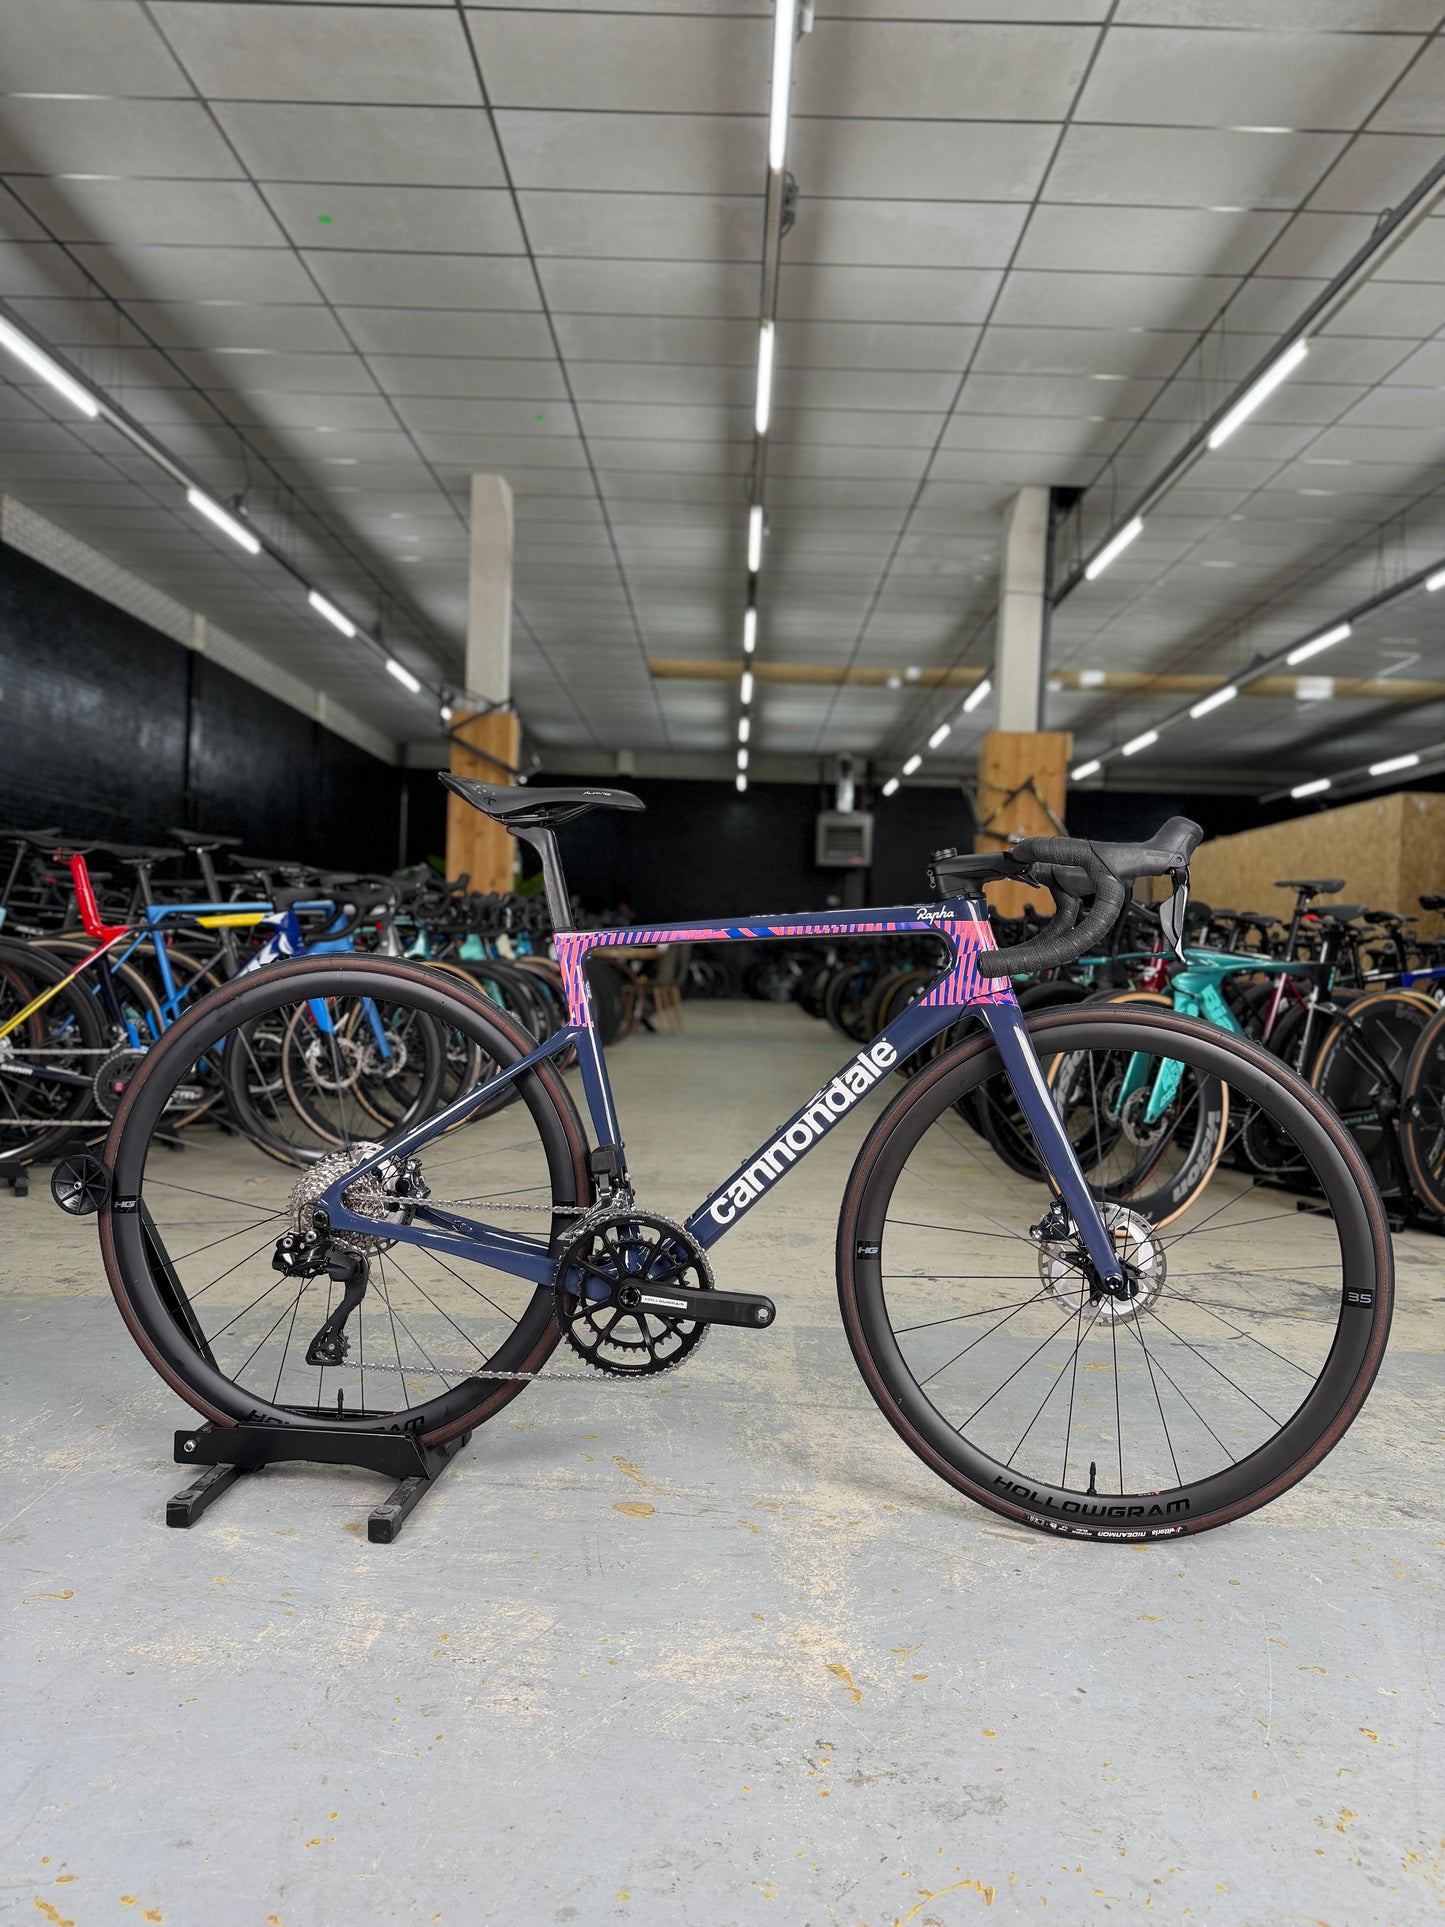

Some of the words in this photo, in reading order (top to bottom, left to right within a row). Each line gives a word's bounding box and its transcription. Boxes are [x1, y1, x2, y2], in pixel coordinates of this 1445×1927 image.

[916, 905, 955, 926] Rapha
[709, 1040, 898, 1225] cannondale
[114, 1200, 136, 1208] HG
[857, 1246, 879, 1254] HG
[1347, 1292, 1372, 1304] 35
[992, 1475, 1191, 1519] HOLLOWGRAM
